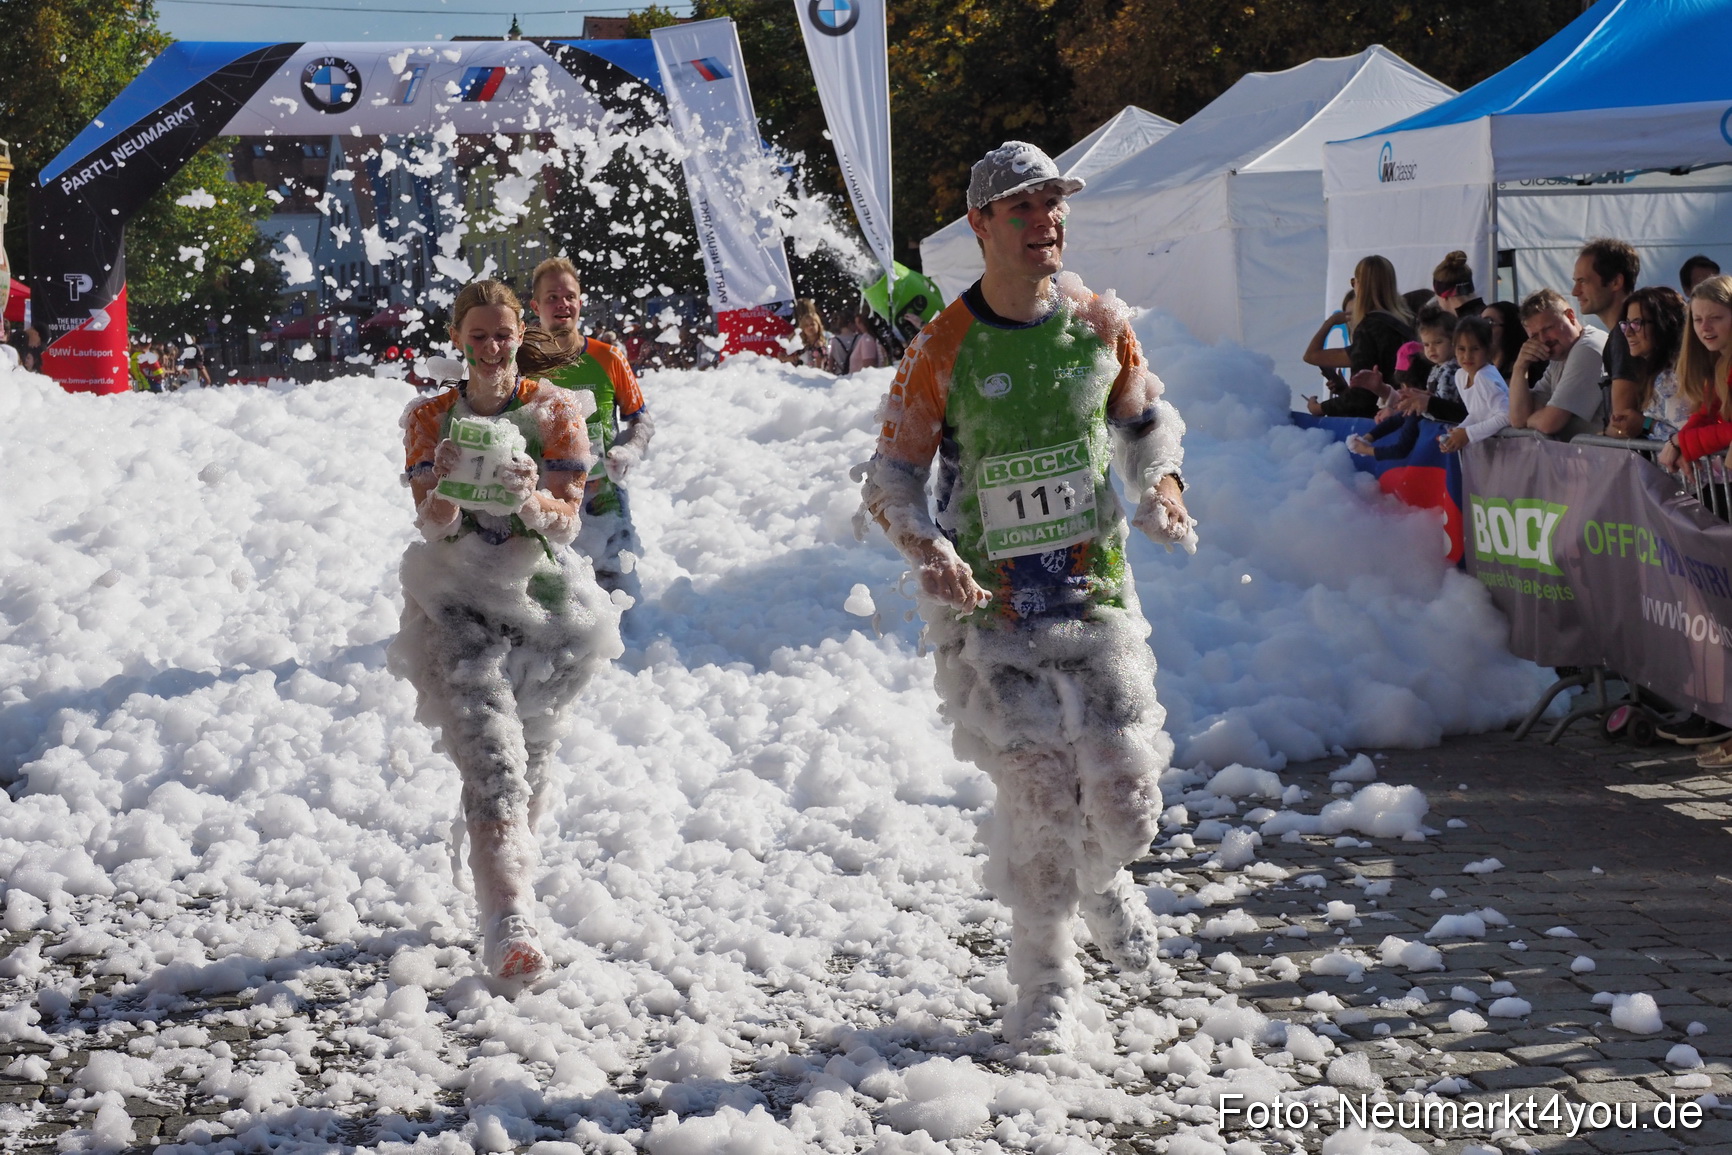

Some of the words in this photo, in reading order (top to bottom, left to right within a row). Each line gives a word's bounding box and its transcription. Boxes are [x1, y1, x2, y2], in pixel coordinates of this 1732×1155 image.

[305, 57, 356, 76] BMW
[61, 159, 114, 196] PARTL
[110, 101, 196, 165] NEUMARKT
[57, 317, 69, 325] THE
[71, 317, 87, 325] NEXT
[49, 348, 71, 357] BMW
[72, 348, 113, 358] Laufsport
[984, 446, 1080, 484] BOCK
